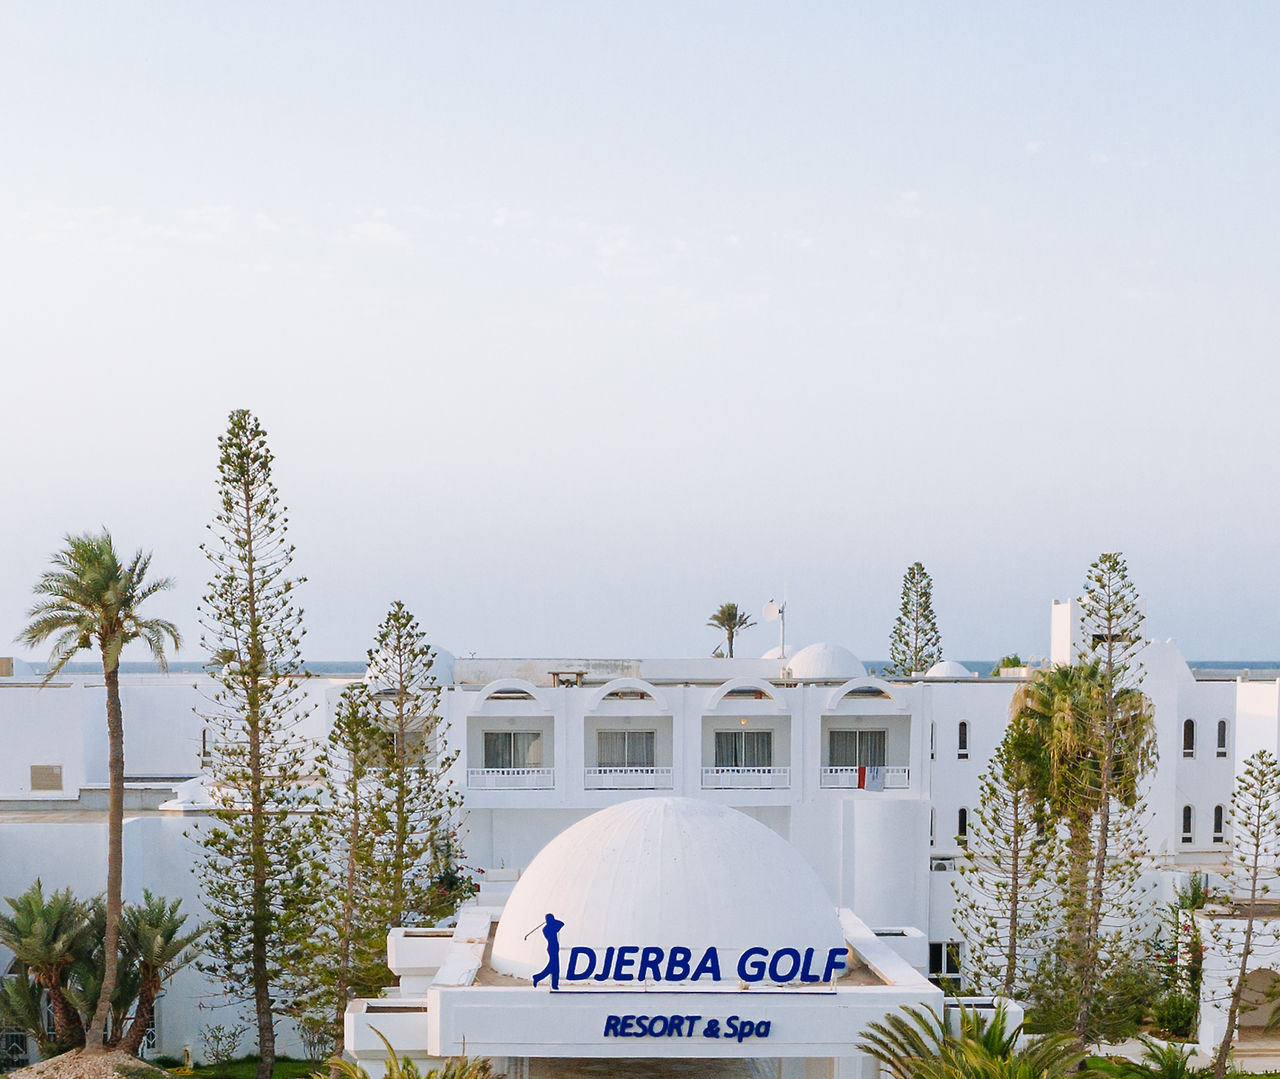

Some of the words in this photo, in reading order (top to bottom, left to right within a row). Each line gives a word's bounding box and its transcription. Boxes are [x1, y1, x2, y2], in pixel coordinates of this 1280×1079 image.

[566, 946, 721, 982] DJERBA
[737, 946, 849, 983] GOLF
[603, 1015, 702, 1038] RESORT
[703, 1019, 720, 1039] &
[724, 1015, 772, 1043] Spa
